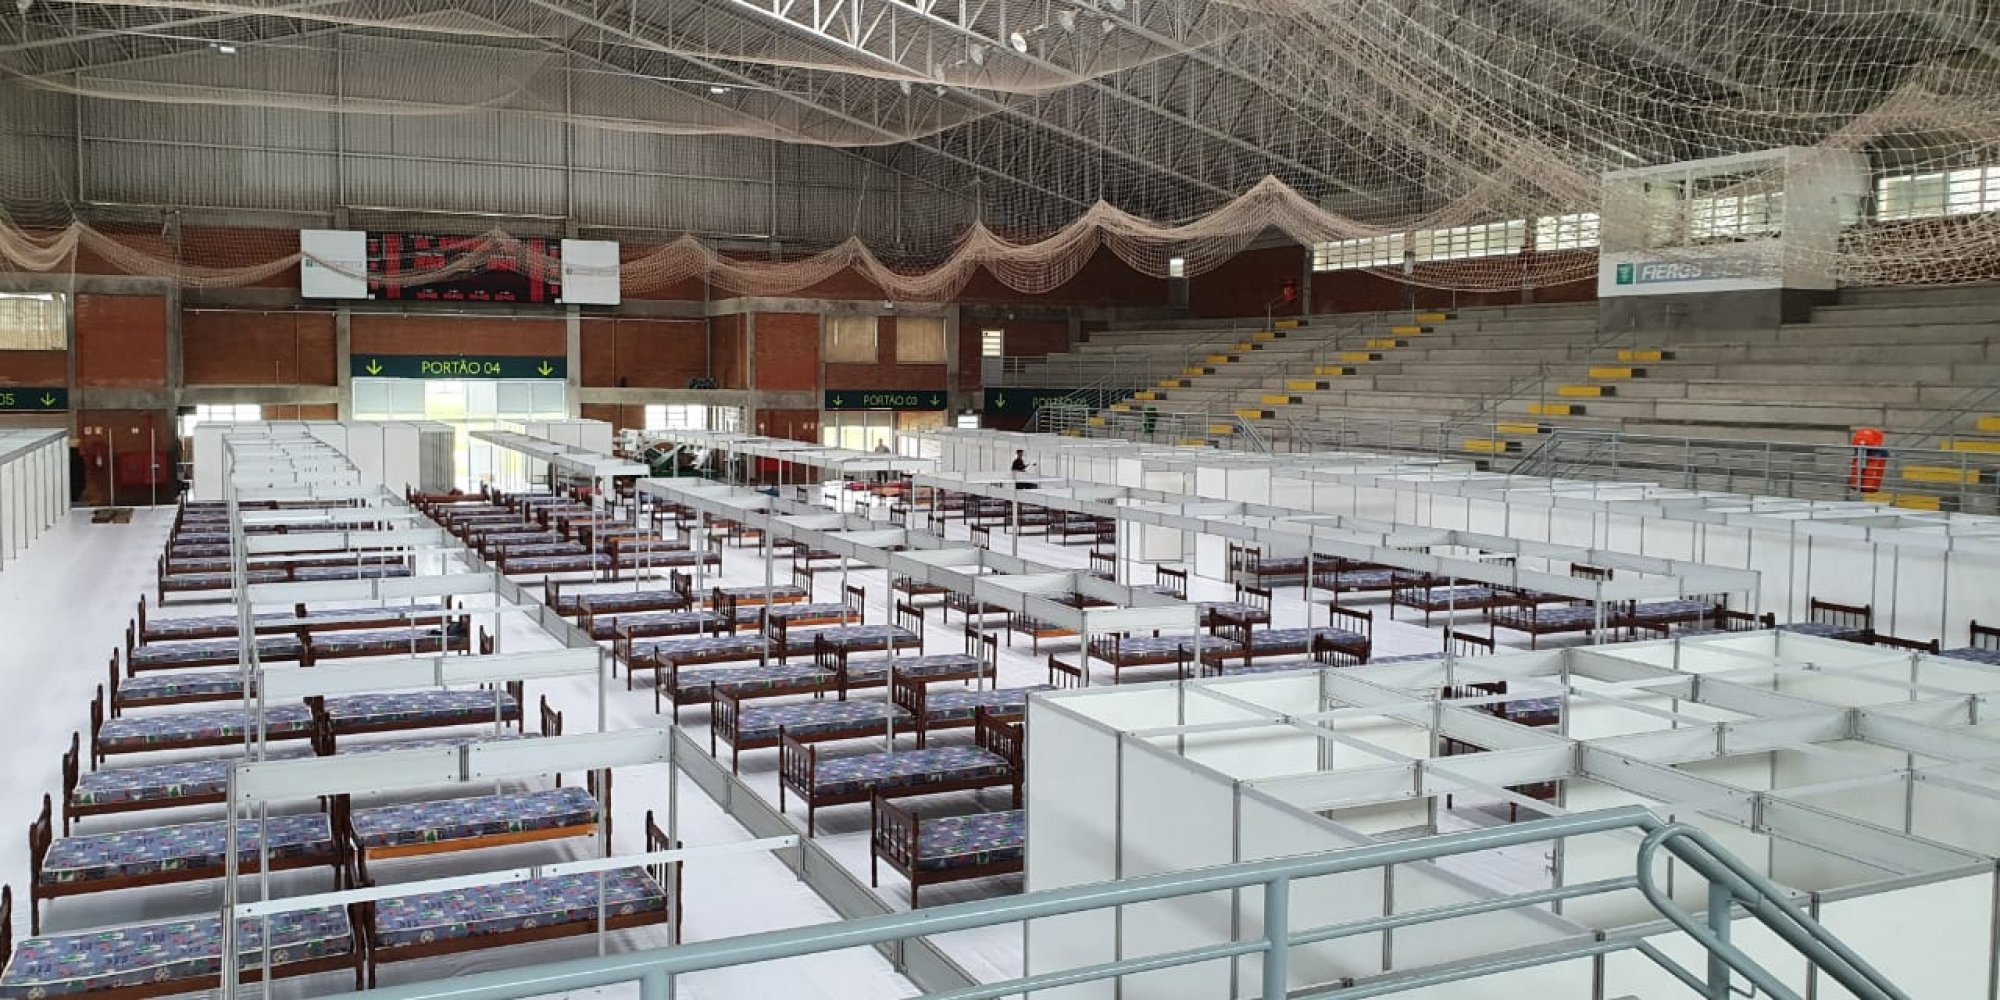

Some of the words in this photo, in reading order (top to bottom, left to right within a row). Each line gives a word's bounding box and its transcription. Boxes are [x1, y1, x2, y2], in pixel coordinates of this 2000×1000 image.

[1642, 263, 1702, 280] FIERGS
[421, 359, 480, 374] PORTÃO
[484, 361, 501, 374] 04
